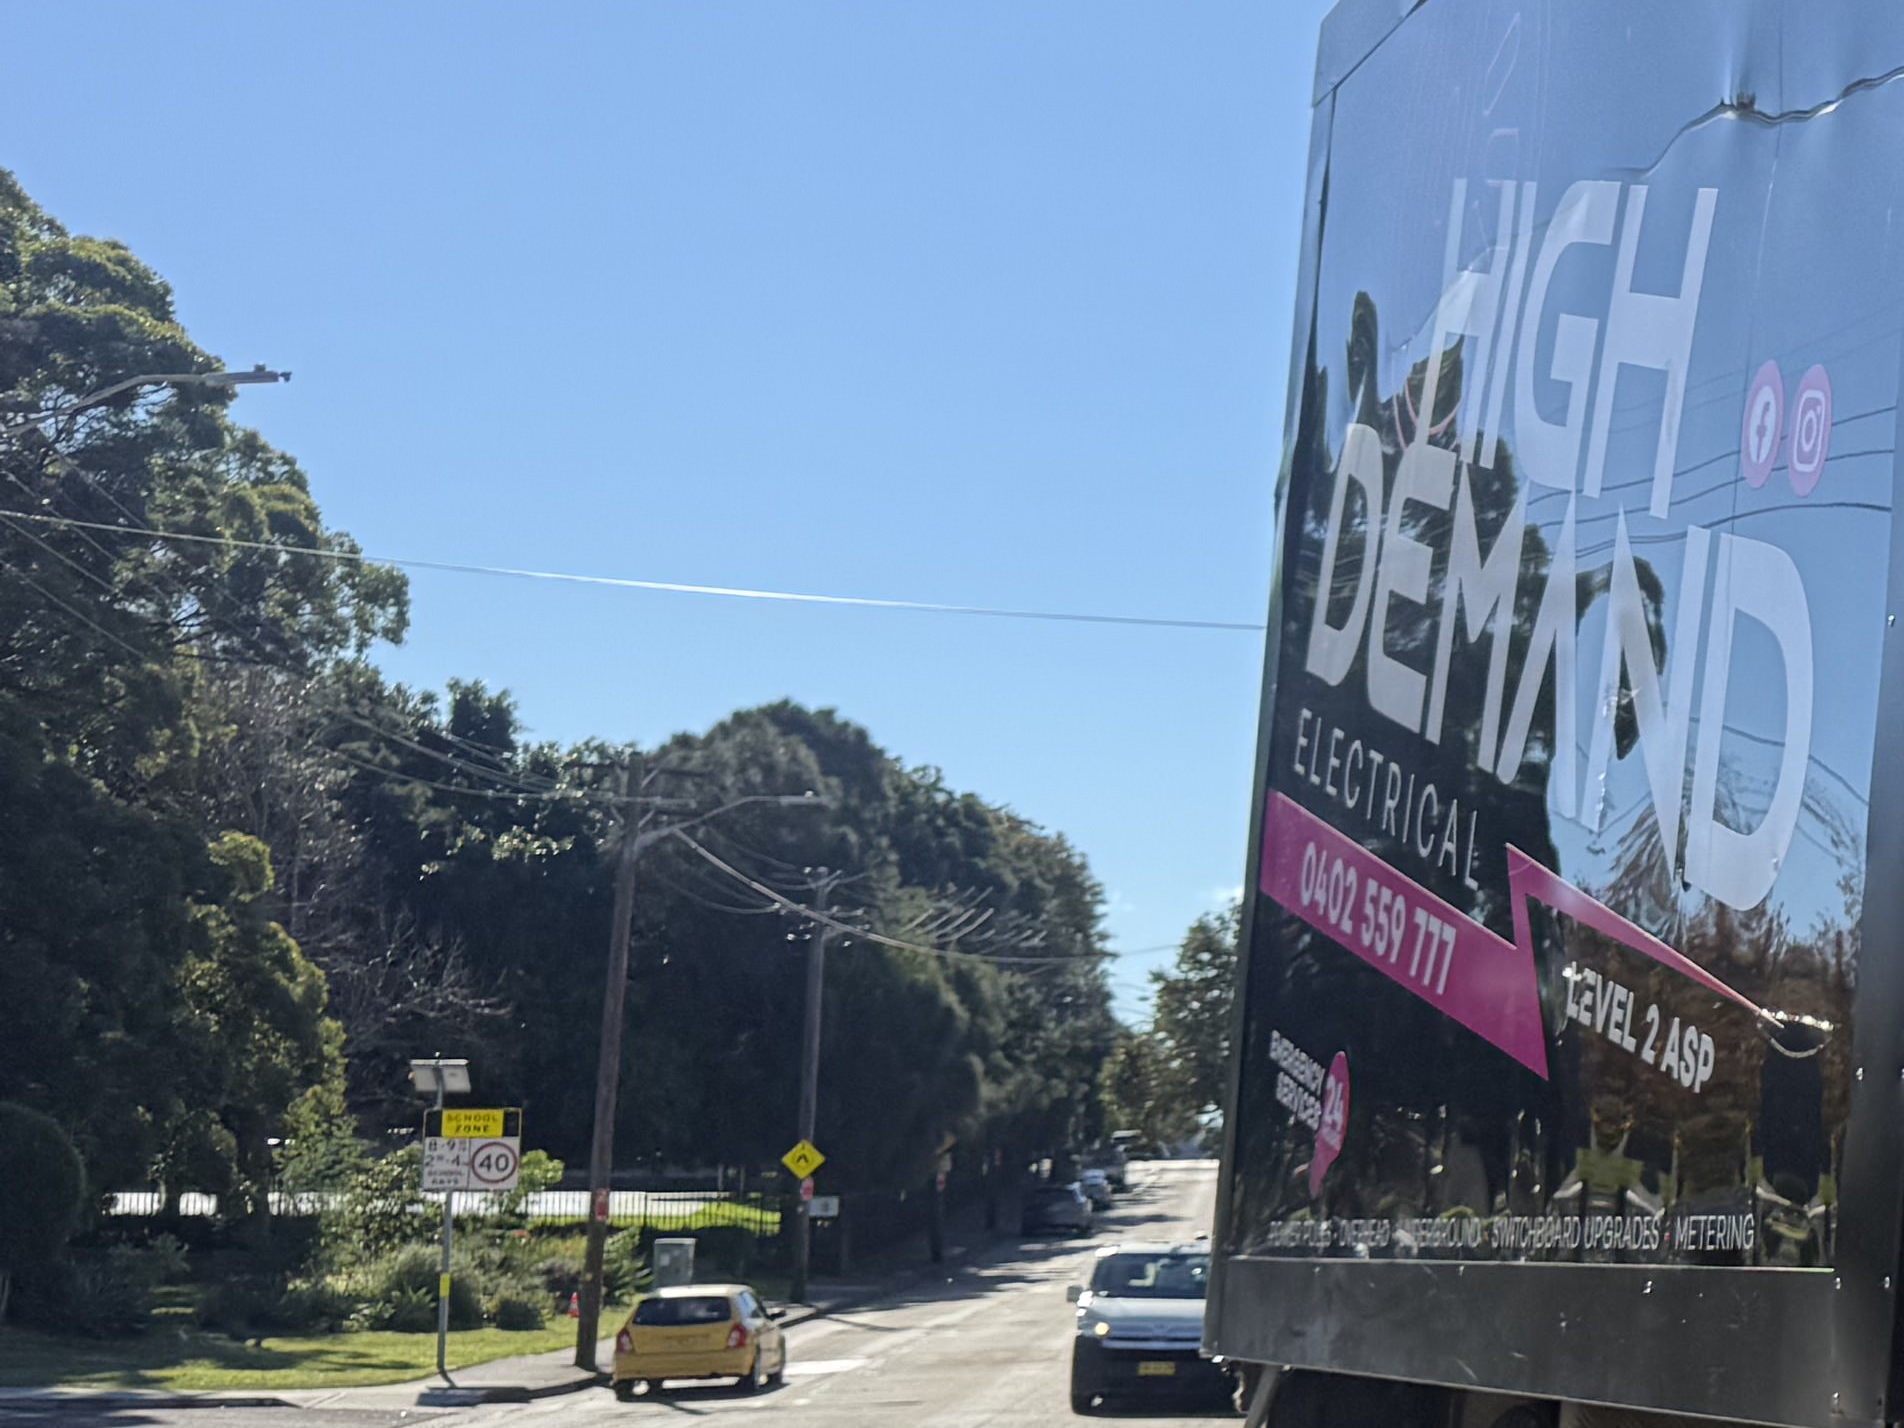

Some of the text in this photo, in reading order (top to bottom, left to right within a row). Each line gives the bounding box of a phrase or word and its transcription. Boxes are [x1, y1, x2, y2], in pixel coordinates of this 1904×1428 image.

[1410, 177, 1719, 520] HIGH
[1305, 423, 1814, 912] DEMAND
[1293, 706, 1480, 892] ELECTRICAL
[1300, 840, 1457, 996] 0402 559 777
[1565, 960, 1715, 1094] LEVEL 2 ASP
[455, 1124, 490, 1133] ZONE
[478, 1153, 510, 1173] 40
[1321, 1073, 1344, 1134] 24
[1491, 1215, 1582, 1250] SWITCHBOARD
[1583, 1215, 1661, 1251] UPGRADES
[1674, 1213, 1755, 1251] METERING
